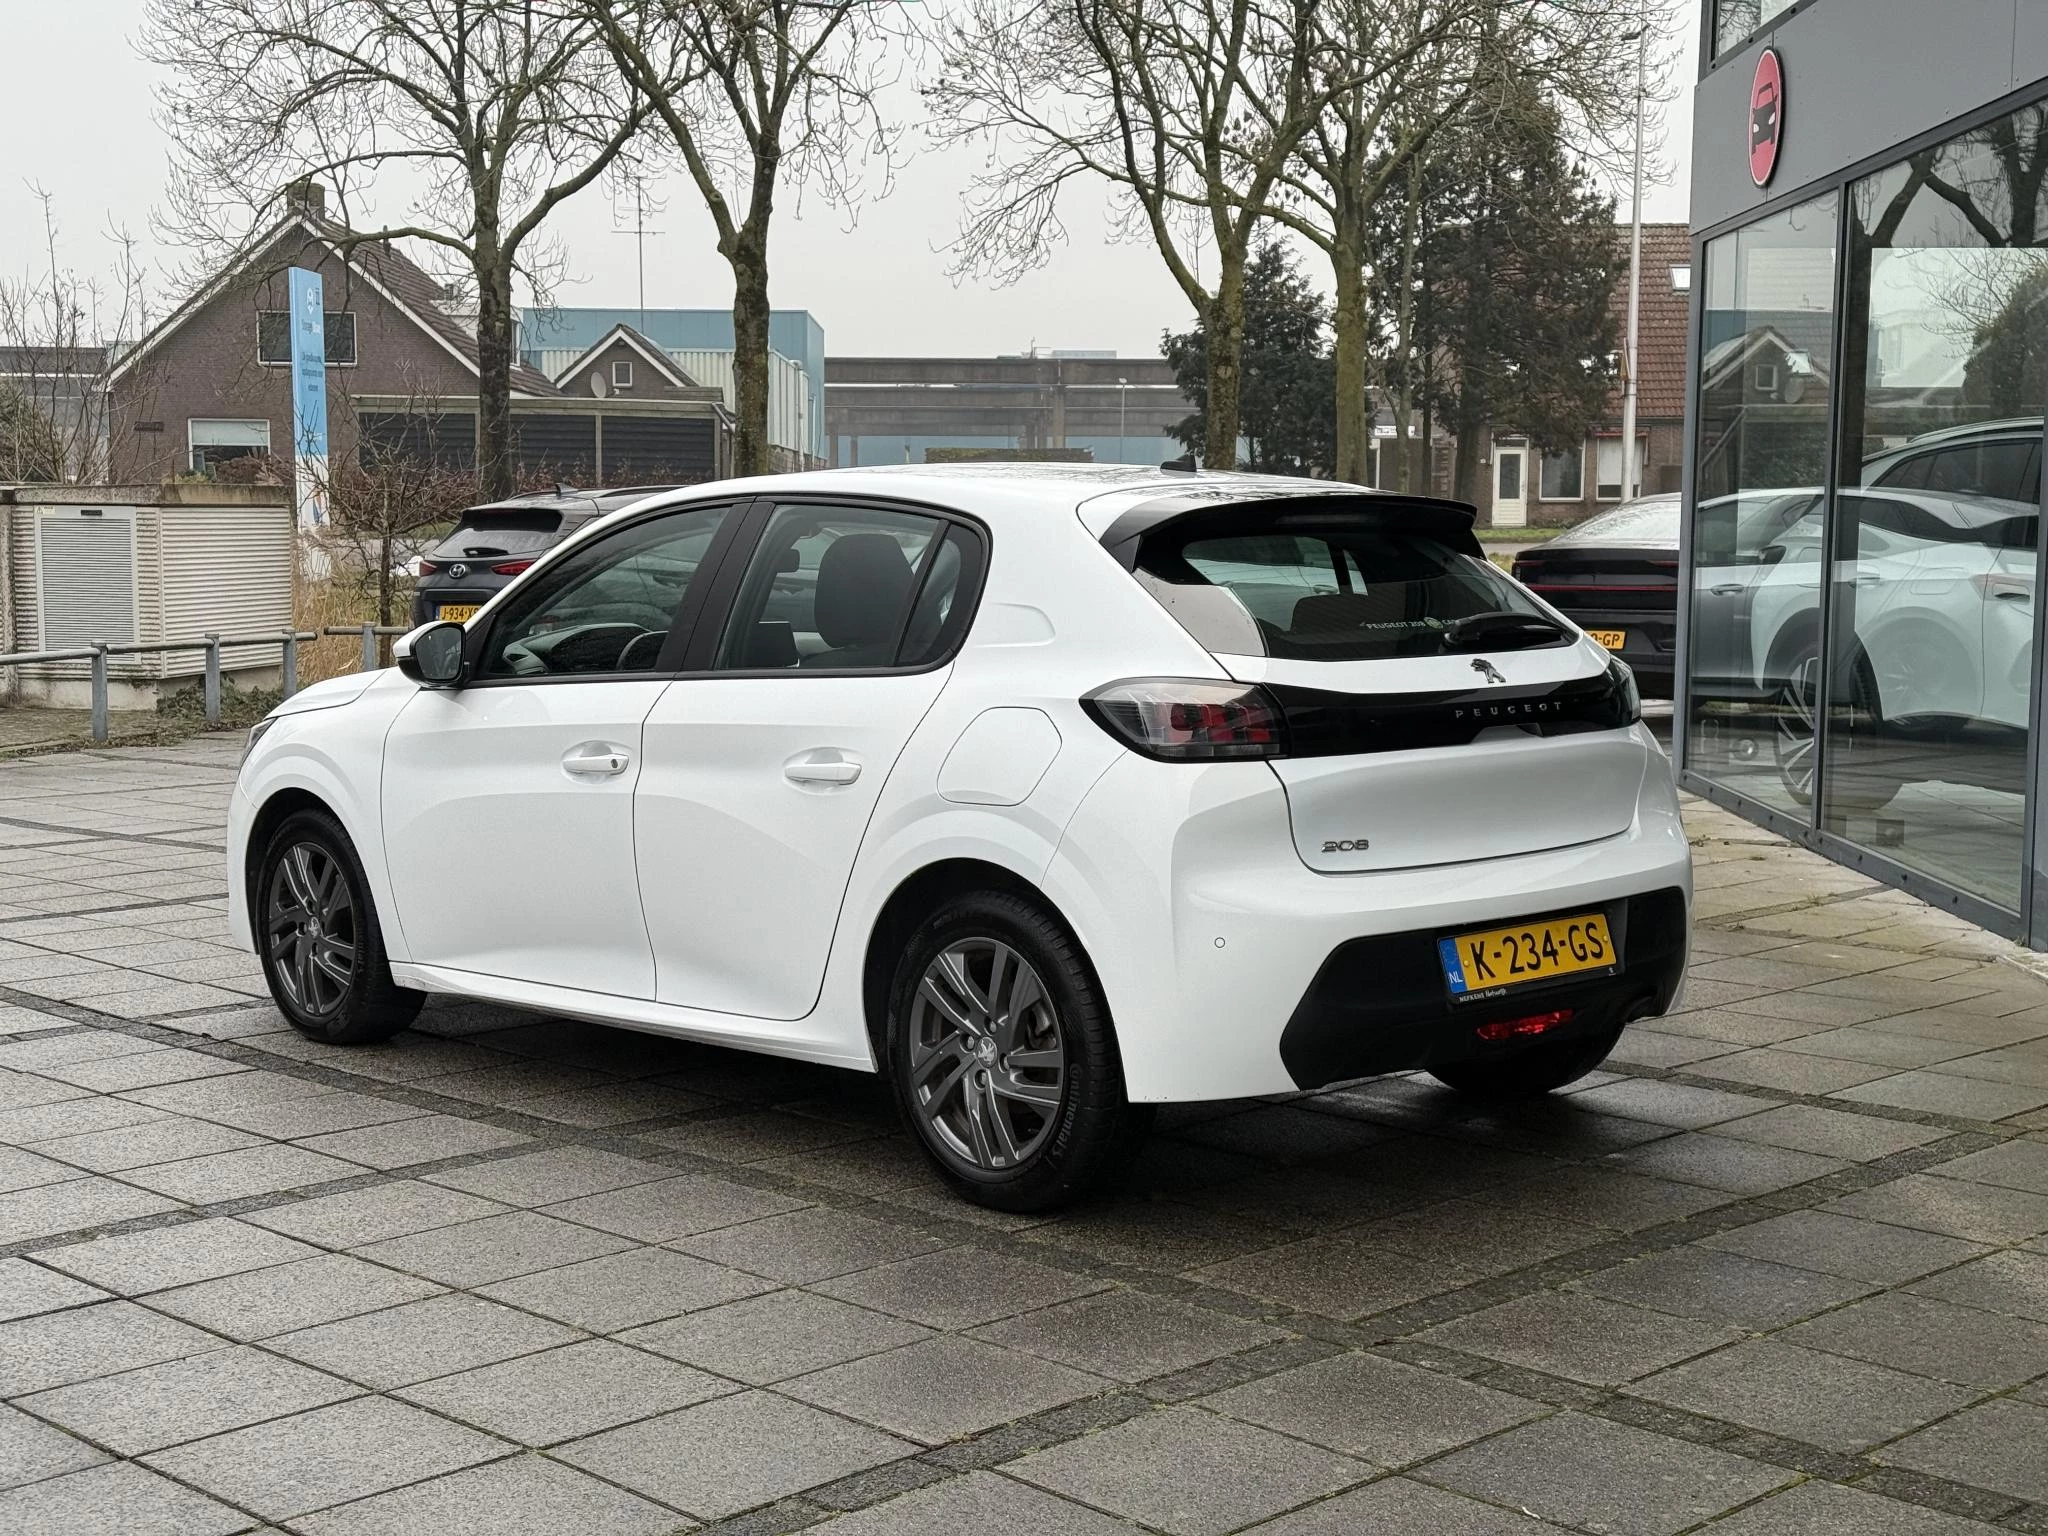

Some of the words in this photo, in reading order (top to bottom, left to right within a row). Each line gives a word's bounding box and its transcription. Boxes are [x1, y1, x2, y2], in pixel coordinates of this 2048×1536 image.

[1366, 621, 1408, 629] PEUGEOT
[1455, 701, 1562, 718] PEUGEOT
[1320, 839, 1369, 852] 208
[1470, 922, 1604, 980] K-234-GS
[1448, 972, 1463, 983] NL
